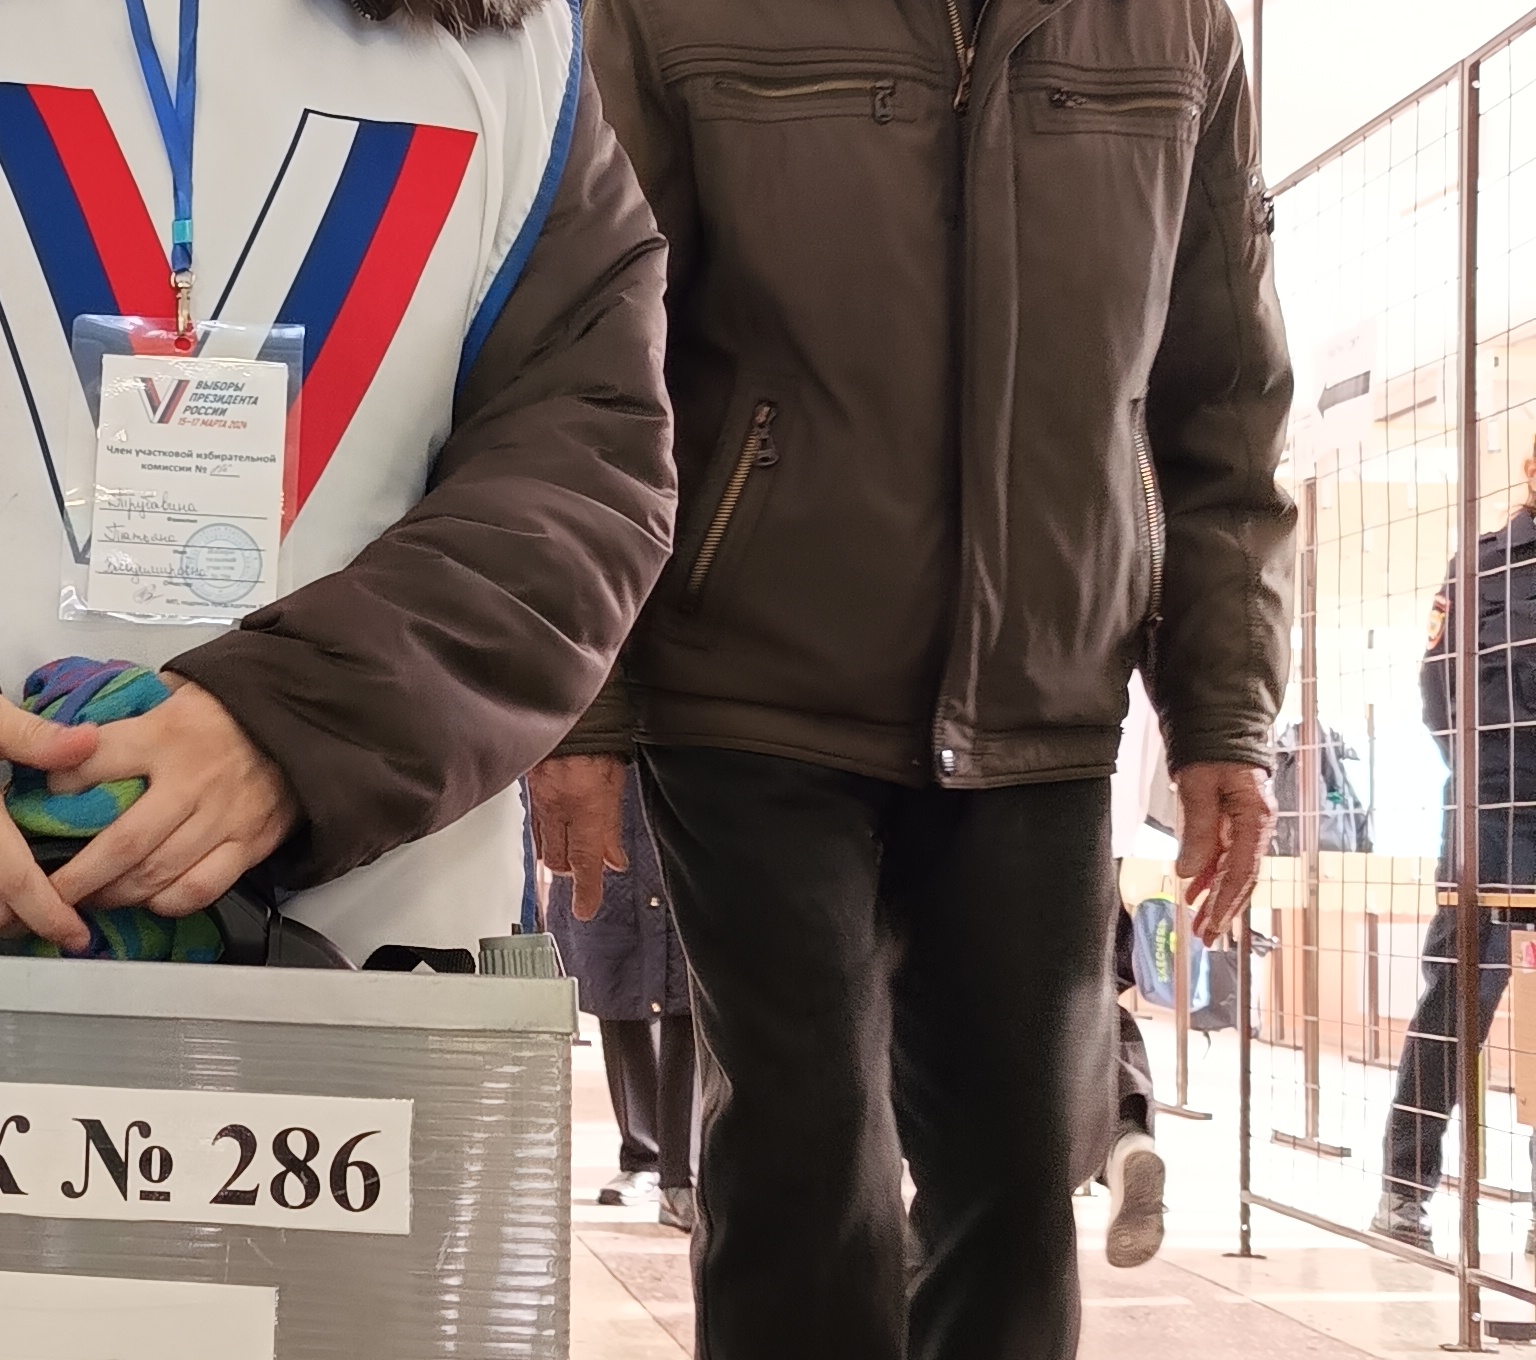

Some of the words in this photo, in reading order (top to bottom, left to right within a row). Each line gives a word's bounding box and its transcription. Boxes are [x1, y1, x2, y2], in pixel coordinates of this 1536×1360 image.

[195, 380, 246, 392] ВЫБОРЫ
[188, 392, 259, 406] ПРЕЗИДЕНТА
[182, 405, 229, 417] РОССИИ
[199, 419, 227, 428] МАРТА
[227, 420, 248, 430] 2024
[106, 445, 133, 456] Член
[135, 447, 194, 459] участковой
[196, 450, 277, 465] избирательной
[141, 462, 192, 474] комиссии
[195, 465, 208, 474] №
[60, 1117, 175, 1202] №
[209, 1124, 383, 1212] 286
